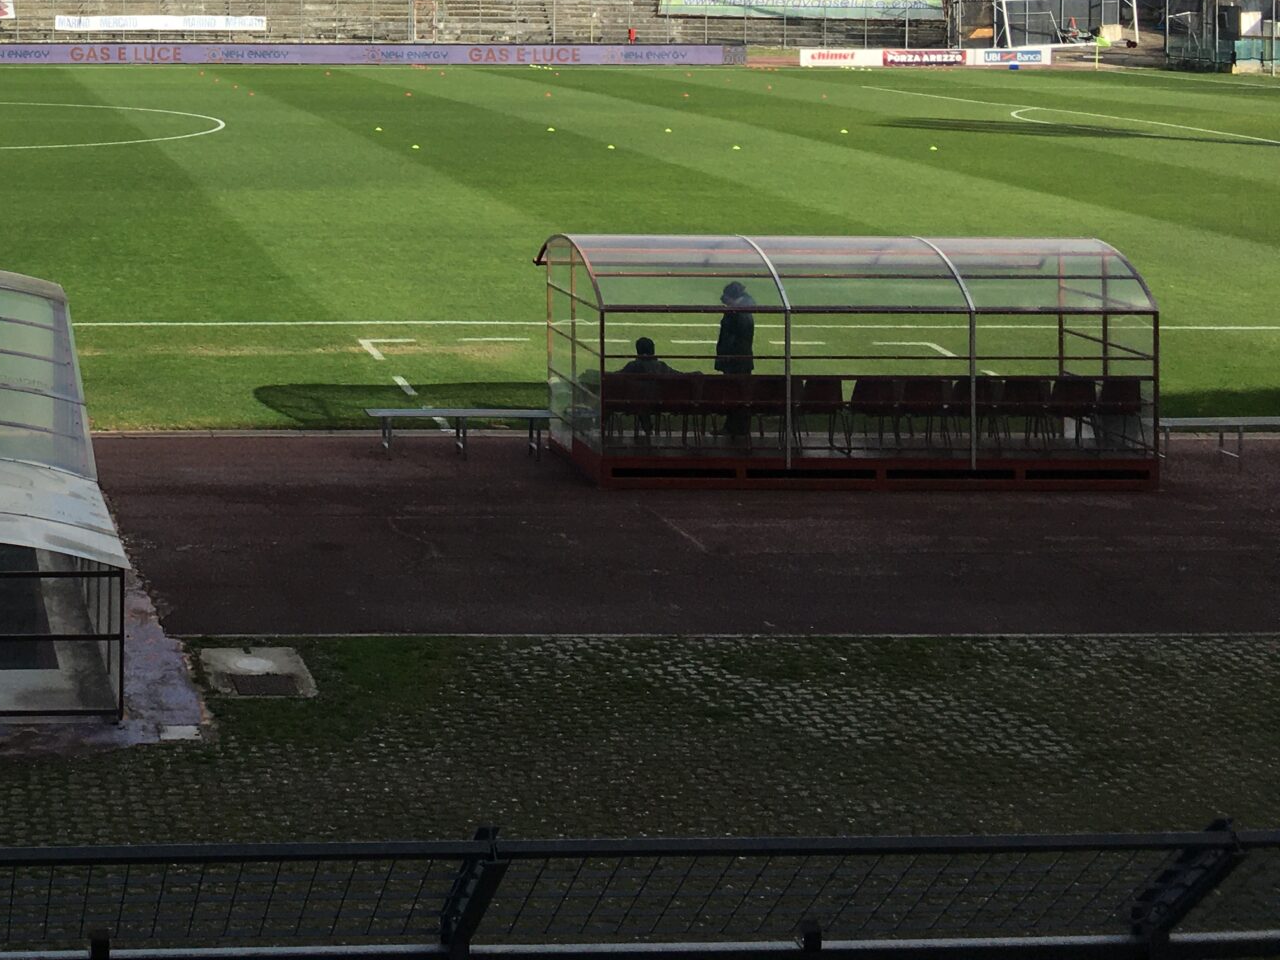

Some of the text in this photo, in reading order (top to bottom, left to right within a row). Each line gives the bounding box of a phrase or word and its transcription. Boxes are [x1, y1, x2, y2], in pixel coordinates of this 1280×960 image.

[70, 47, 182, 61] GAS E LUCE
[468, 47, 580, 62] GAS E LUCE
[811, 51, 856, 61] chimet
[886, 53, 963, 63] FORZA AREZZO
[985, 51, 1041, 62] UBI Banca
